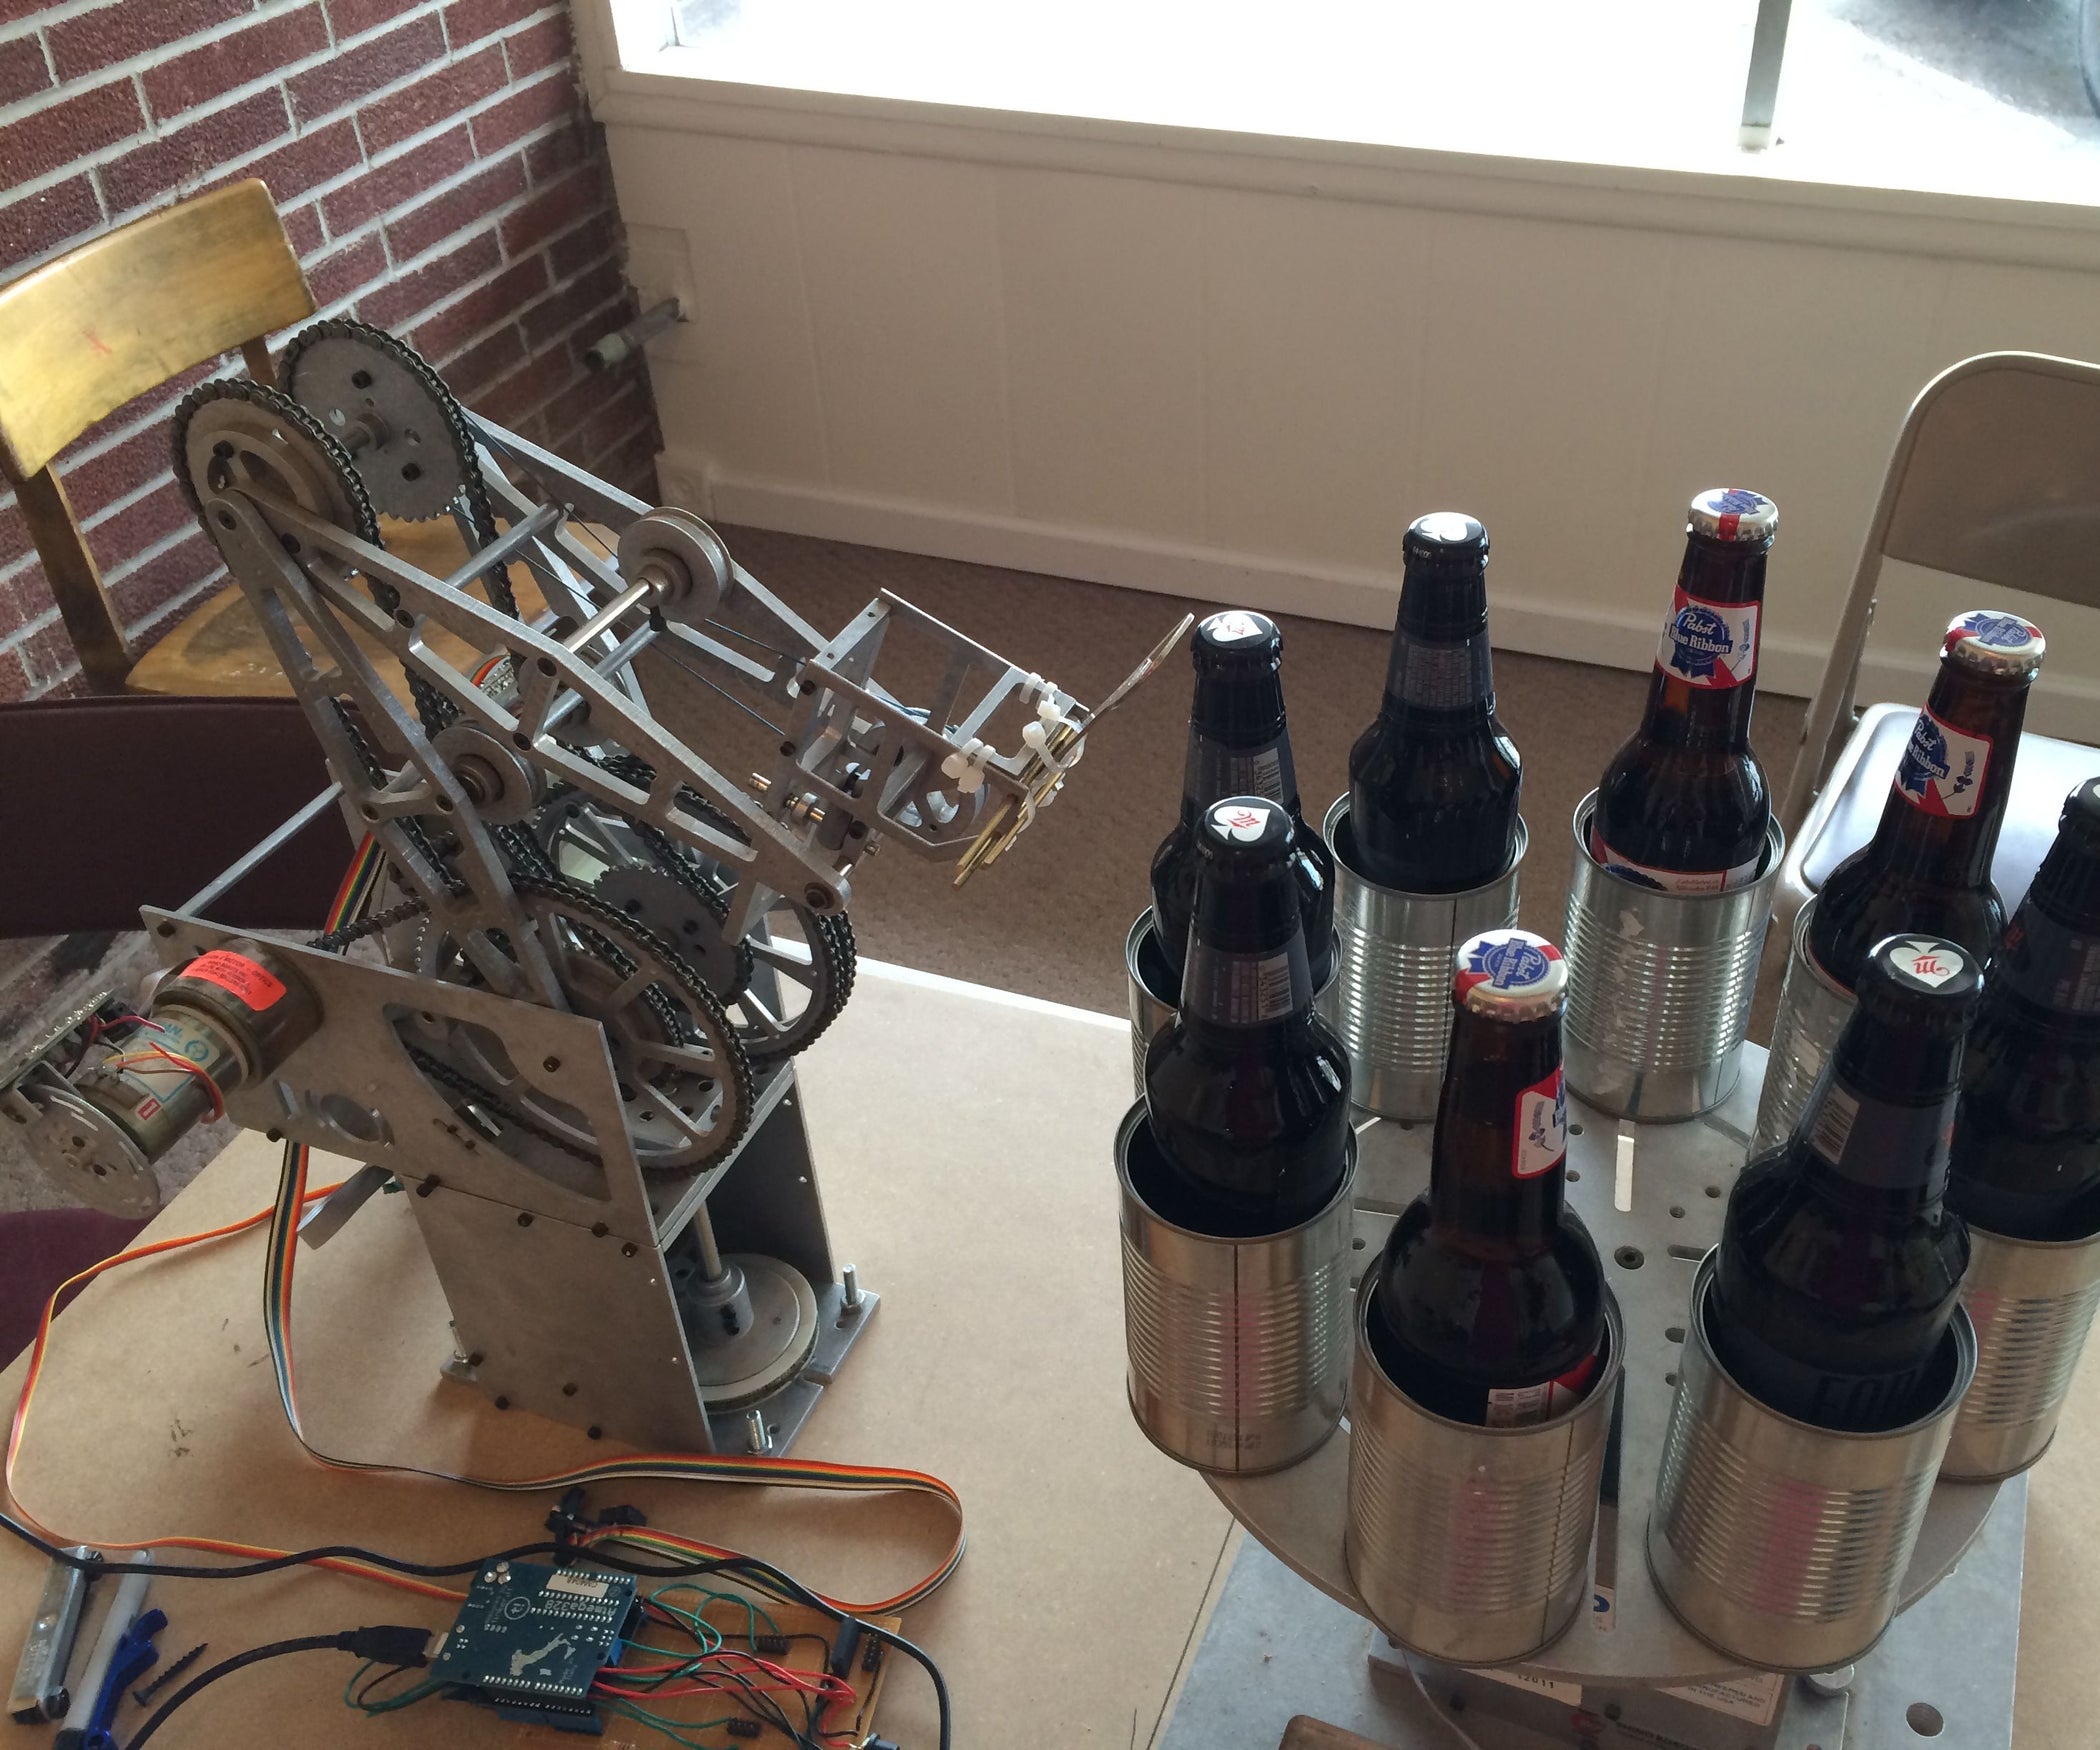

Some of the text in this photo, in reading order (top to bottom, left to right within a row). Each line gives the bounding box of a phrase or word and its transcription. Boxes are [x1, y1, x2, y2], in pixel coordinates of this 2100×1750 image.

[1683, 613, 1717, 636] Pabst
[1670, 625, 1730, 653] Blue Ribbon
[1914, 719, 1936, 752] Pabst
[1912, 746, 1946, 778] Ribbon
[1515, 951, 1542, 980] Pabst
[544, 1599, 618, 1618] Atmega328
